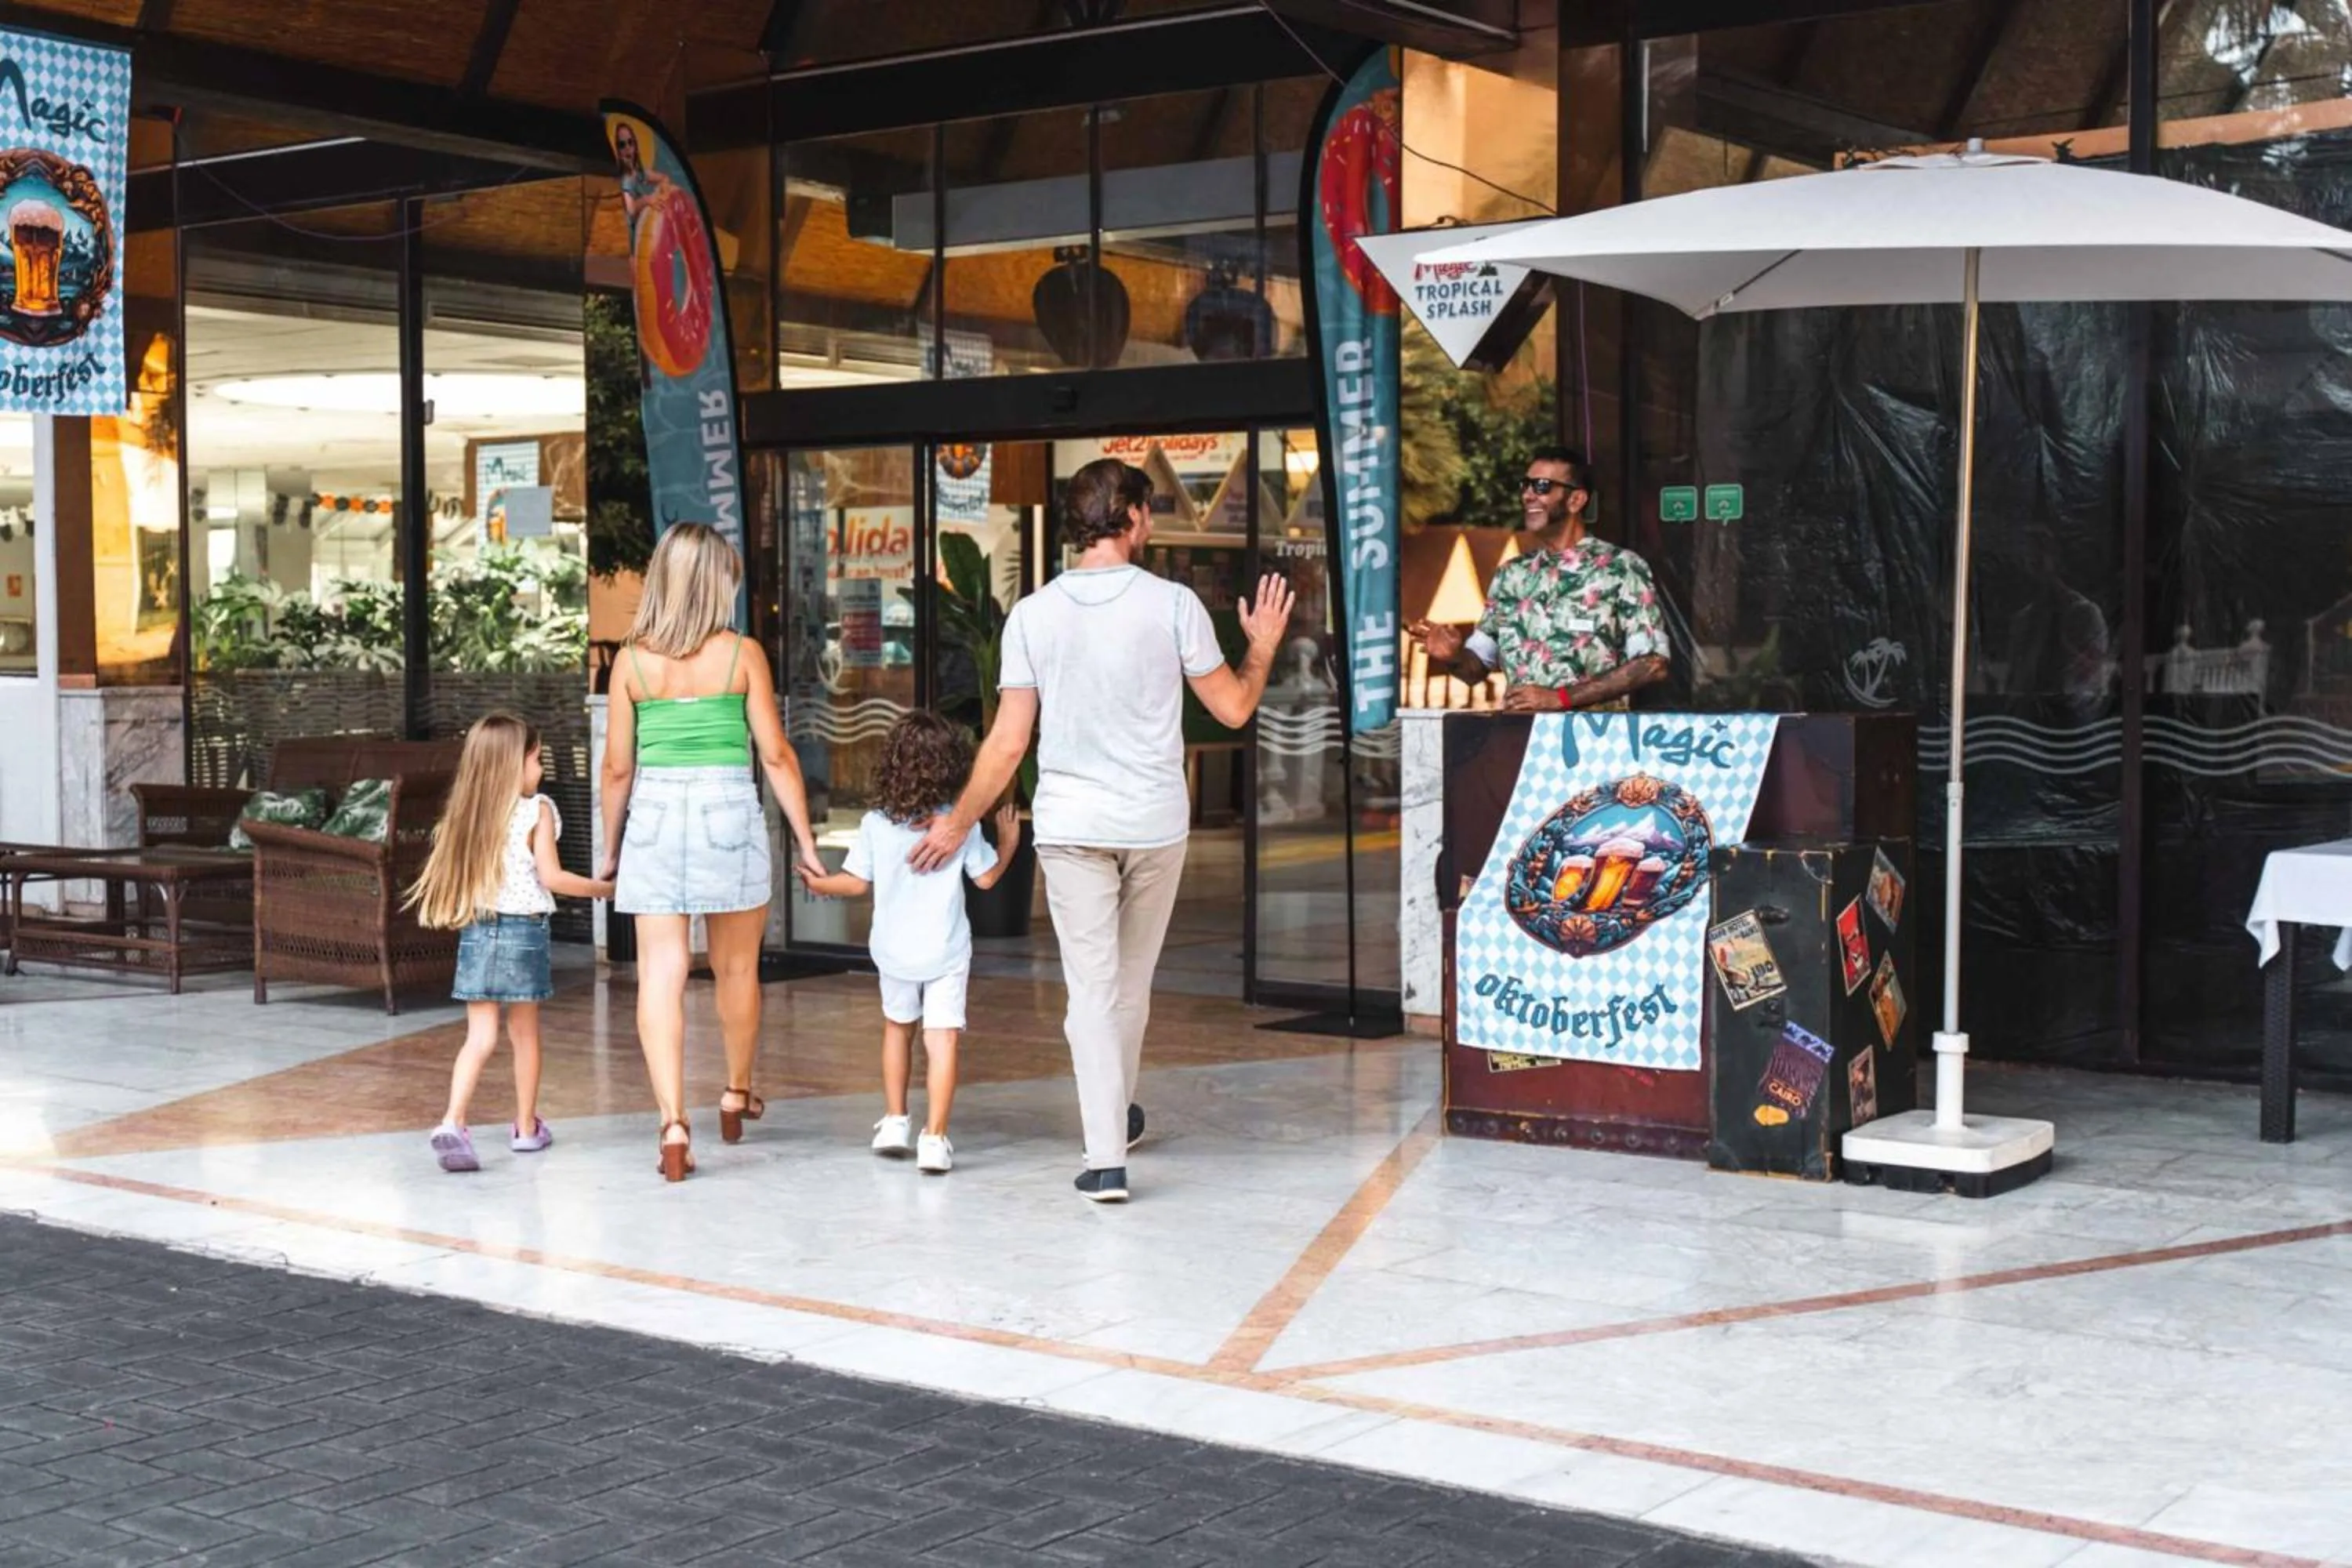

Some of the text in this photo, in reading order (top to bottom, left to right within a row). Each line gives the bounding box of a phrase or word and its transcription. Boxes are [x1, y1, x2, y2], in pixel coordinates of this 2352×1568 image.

[1415, 279, 1504, 301] TROPICAL
[1426, 299, 1492, 320] SPLASH
[1335, 336, 1394, 713] THE SUMMER
[1562, 712, 1735, 768] Magic
[1475, 973, 1678, 1048] oktoberfest
